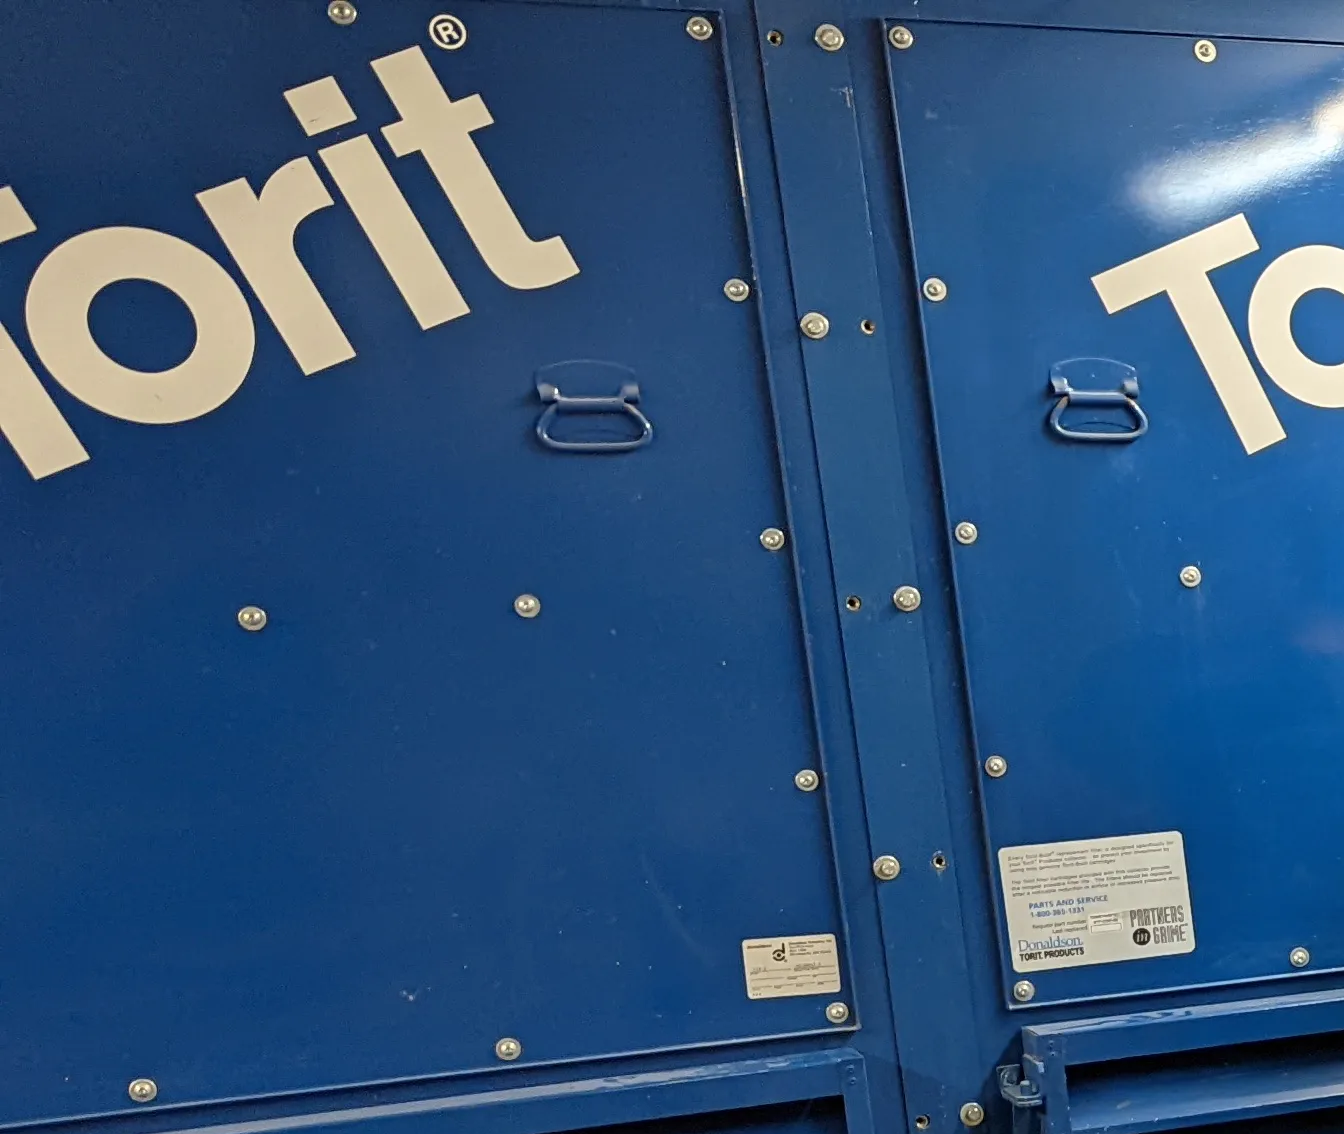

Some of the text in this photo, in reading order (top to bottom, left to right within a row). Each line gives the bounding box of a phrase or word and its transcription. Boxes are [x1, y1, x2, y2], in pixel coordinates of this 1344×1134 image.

[1029, 901, 1053, 910] PARTS
[1077, 895, 1108, 904] SERVICE
[1129, 904, 1185, 928] PARTNERS
[1044, 947, 1085, 959] PRODUCTS
